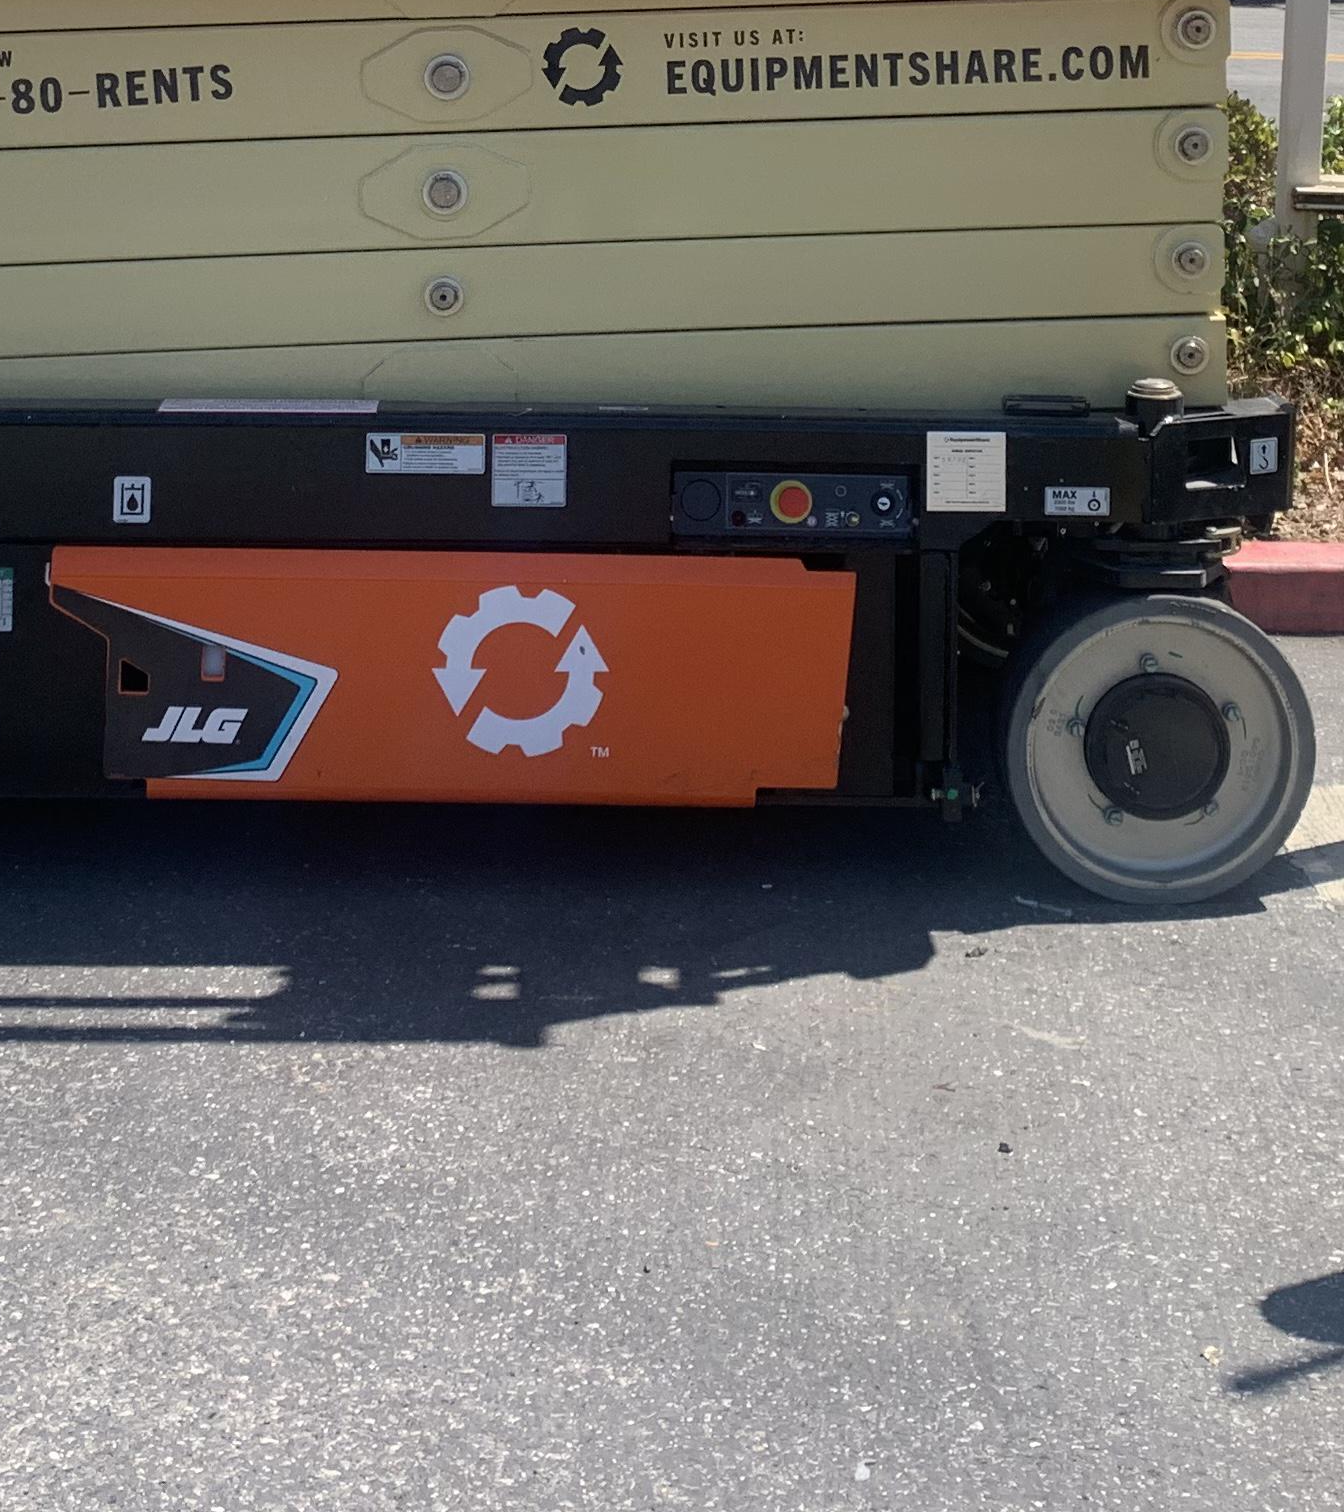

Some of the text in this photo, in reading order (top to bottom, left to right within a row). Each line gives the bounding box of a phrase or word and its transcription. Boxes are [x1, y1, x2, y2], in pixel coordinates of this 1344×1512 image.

[663, 28, 806, 49] VISIT US AT:
[666, 44, 1151, 98] EQUIPMENTSHARE.COM
[1052, 490, 1078, 500] MAX
[141, 706, 249, 744] JLG
